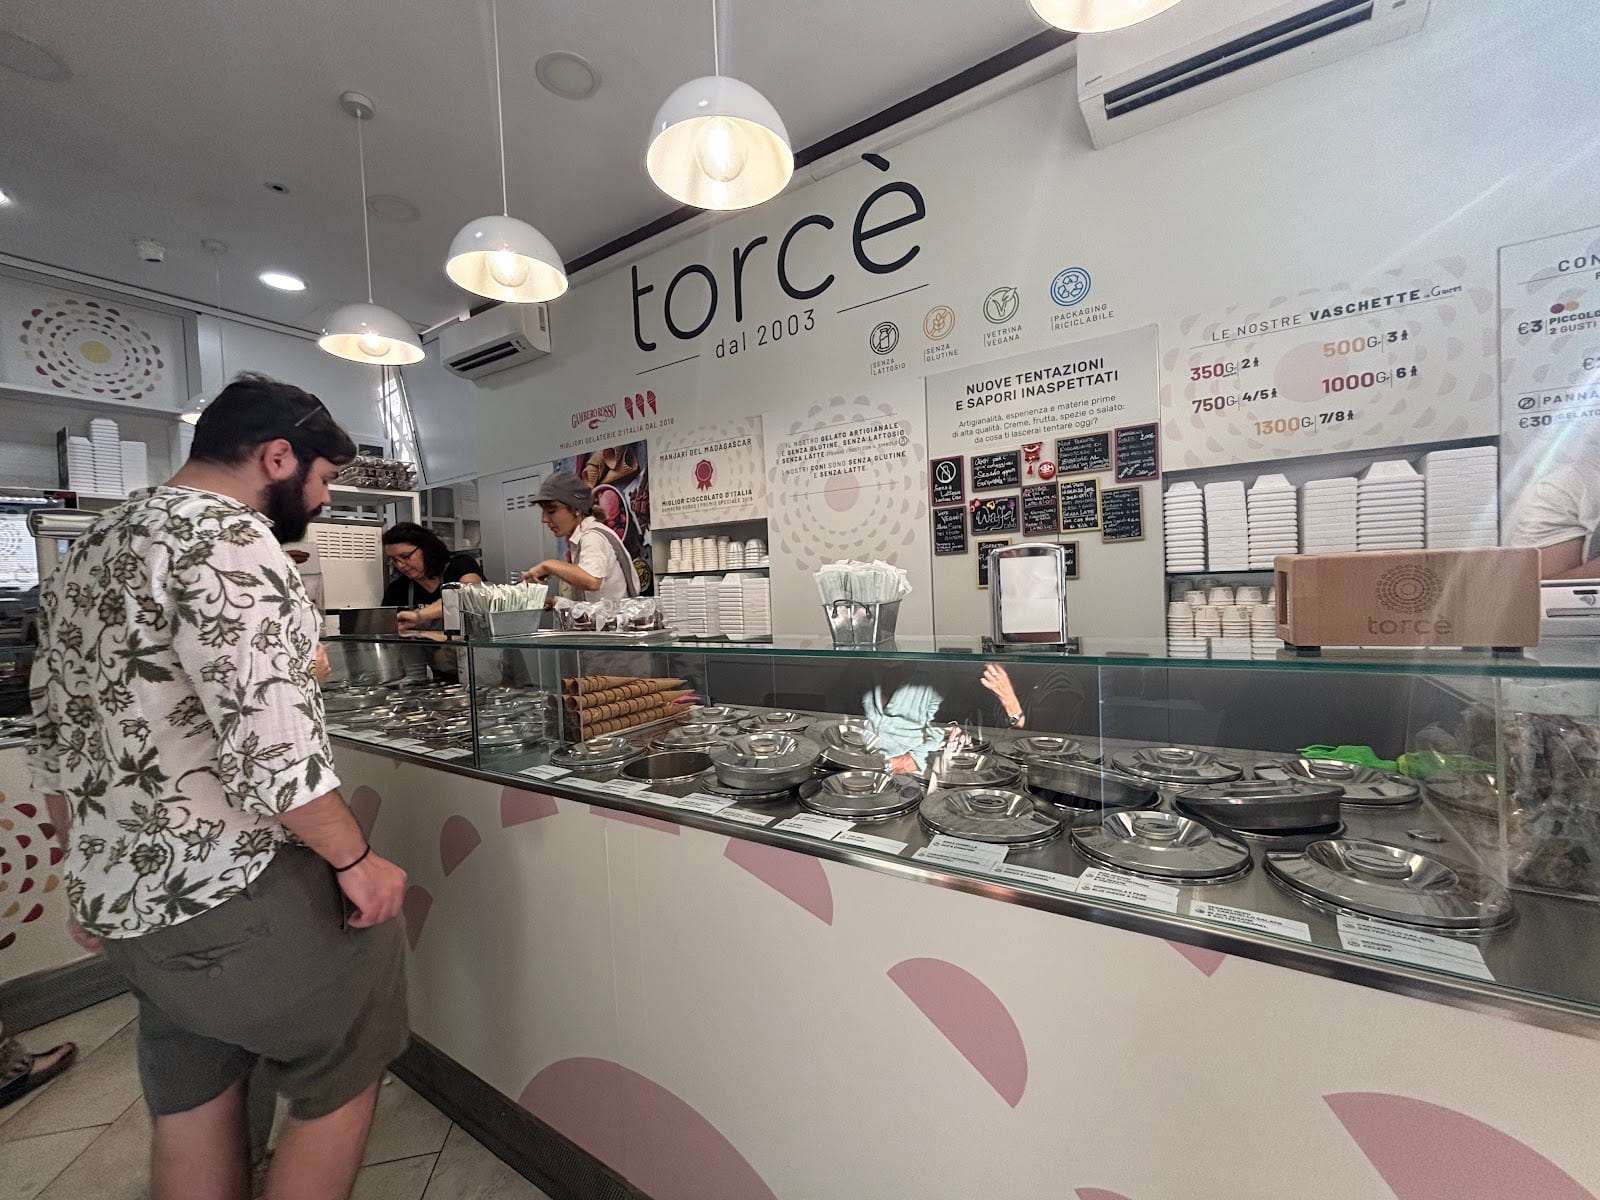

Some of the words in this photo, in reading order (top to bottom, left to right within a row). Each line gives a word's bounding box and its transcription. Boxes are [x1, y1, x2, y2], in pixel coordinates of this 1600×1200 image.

[632, 153, 926, 352] torcè
[1055, 304, 1107, 322] PACKAGING
[1055, 311, 1115, 331] RICICLABILE
[1212, 329, 1230, 342] LE
[1237, 314, 1302, 337] NOSTRE
[1310, 289, 1421, 321] VASCHETTE
[716, 335, 747, 358] dal
[757, 309, 816, 347] 2003
[987, 325, 1022, 338] VETRINA
[1518, 319, 1543, 334] €3
[1549, 327, 1557, 335] 2
[1560, 321, 1596, 333] GUSTI
[987, 334, 1020, 347] VEGANA
[1387, 331, 1398, 343] 3
[926, 344, 951, 354] SENZA
[926, 349, 958, 363] GLUTINE
[873, 358, 895, 368] SENZA
[873, 363, 906, 375] LATTOSIO
[1242, 358, 1251, 369] 2
[966, 376, 1012, 396] NUOVE
[1016, 357, 1105, 385] TENTAZIONI
[1396, 367, 1407, 379] 6
[956, 401, 964, 411] E
[967, 390, 1017, 409] SAPORI
[1021, 370, 1118, 398] INASPETTATI
[1242, 389, 1269, 402] 4/5
[1006, 407, 1048, 423] esperienza
[1057, 399, 1089, 412] materie
[1091, 395, 1116, 409] prime
[952, 429, 960, 439] di
[962, 427, 974, 437] alta
[1060, 409, 1087, 425] spezie
[1097, 402, 1125, 414] salato:
[1319, 411, 1345, 424] 7/8
[1519, 415, 1553, 429] €30
[560, 439, 584, 449] MIGLIORI
[645, 421, 658, 432] DAL
[794, 437, 819, 447] NOSTRO
[820, 432, 847, 442] GELATO
[849, 422, 899, 438] ARTIGIANALE
[974, 434, 984, 445] da
[985, 434, 1003, 443] cosa
[1004, 431, 1010, 440] ti
[1011, 426, 1041, 439] lascerai
[1043, 421, 1073, 433] tentare
[1075, 416, 1099, 431] oggi?
[660, 452, 687, 462] MANJARI
[690, 448, 702, 457] DEL
[704, 439, 752, 453] MADAGASCAR
[787, 447, 808, 456] SENZA
[843, 436, 866, 446] SENZA
[868, 429, 905, 443] LATTOSIO
[782, 456, 803, 464] SENZA
[804, 451, 825, 461] LATTE
[810, 464, 826, 472] CONI
[827, 460, 846, 470] SONO
[848, 457, 871, 466] SENZA
[874, 450, 907, 462] GLUTINE
[820, 469, 842, 478] SENZA
[662, 497, 685, 507] MIGLIOR
[686, 492, 723, 504] CIOCCOLATO
[725, 489, 753, 499] D'ITALIA
